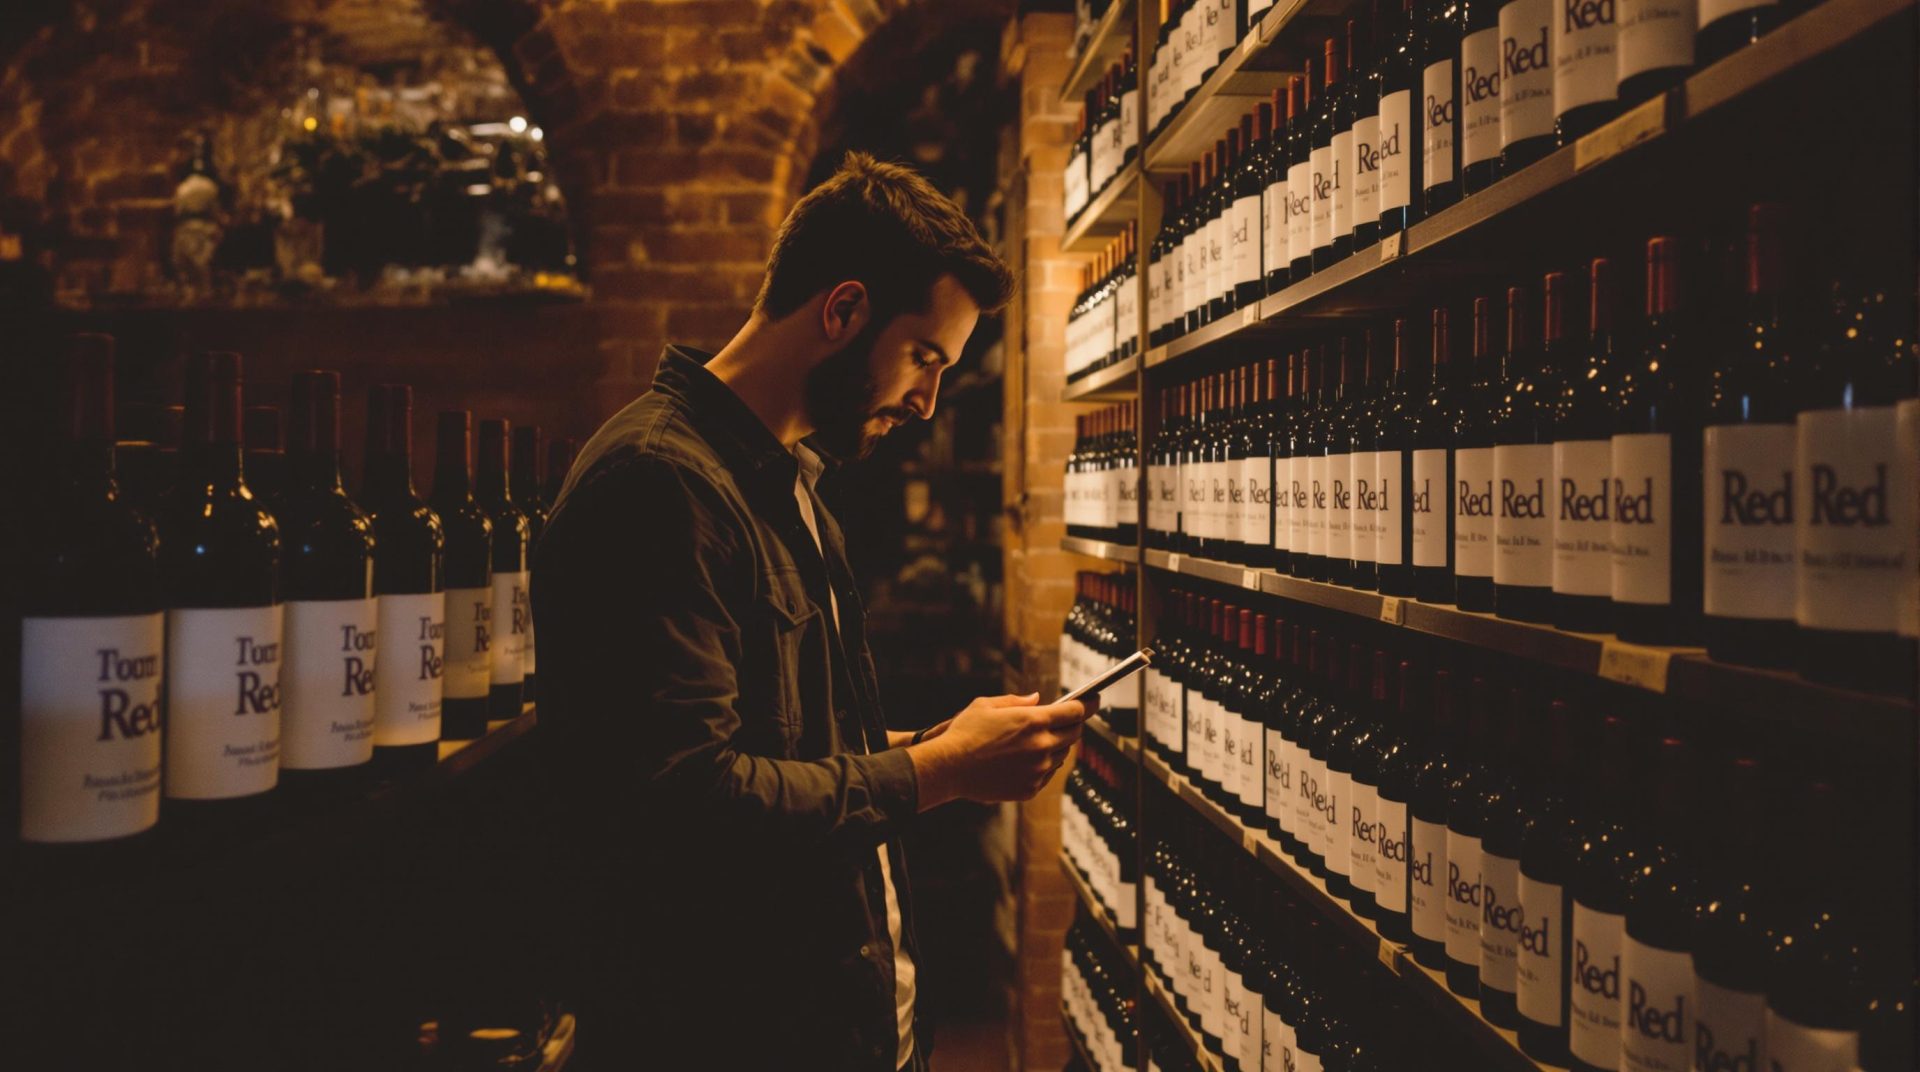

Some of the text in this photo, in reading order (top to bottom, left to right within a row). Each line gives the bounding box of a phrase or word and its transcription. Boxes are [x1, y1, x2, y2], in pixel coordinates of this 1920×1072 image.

[1564, 0, 1616, 34] Red
[1503, 26, 1549, 79] Red
[1357, 143, 1379, 174] Re
[1292, 480, 1308, 509] Re
[1313, 480, 1326, 510] Re
[1334, 480, 1350, 510] Re
[1413, 478, 1431, 513] ed
[1459, 480, 1493, 517] Red
[1501, 478, 1545, 519] Red
[1560, 478, 1610, 521] Red
[1613, 477, 1654, 524] Red
[1721, 469, 1793, 525] Red
[1810, 463, 1890, 526] Red
[474, 625, 490, 652] Re
[342, 657, 376, 697] Re
[419, 645, 442, 680] Re
[1379, 822, 1406, 863] Red
[1412, 851, 1433, 887] ed
[1520, 916, 1550, 958] ed
[1575, 939, 1621, 999] Red
[1629, 978, 1686, 1044] Red
